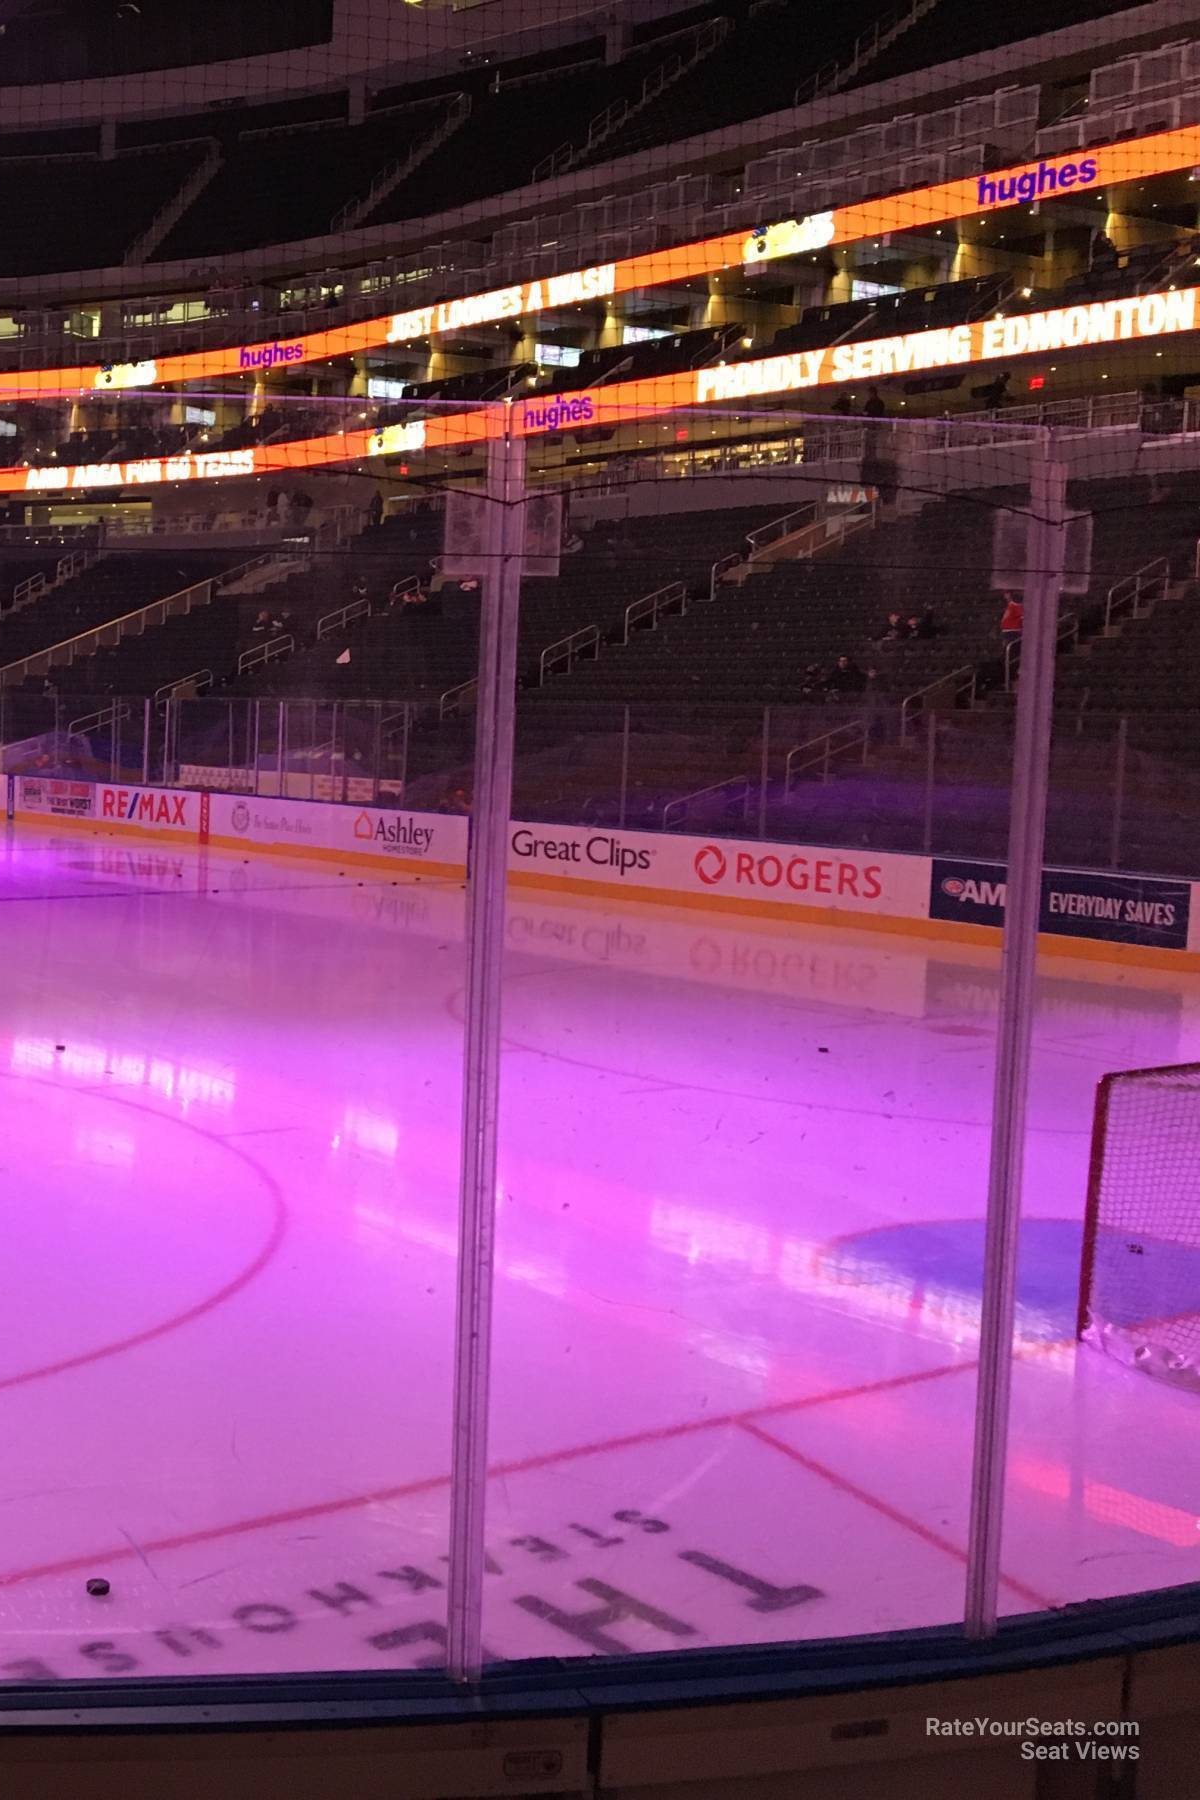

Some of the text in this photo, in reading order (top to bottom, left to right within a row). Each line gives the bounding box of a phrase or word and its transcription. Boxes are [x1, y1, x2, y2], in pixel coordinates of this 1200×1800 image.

[977, 157, 1097, 205] hughes
[387, 305, 434, 343] JUST
[527, 281, 543, 311] A
[548, 263, 616, 306] WASH
[240, 342, 303, 368] hughes
[697, 289, 1195, 402] PROUDLY SERVING EDMONTON
[522, 395, 593, 429] hughes
[103, 789, 186, 826] RE/MAX
[374, 816, 435, 853] Ashley
[511, 829, 651, 876] Great Clips
[736, 852, 882, 899] ROGERS
[1050, 892, 1122, 919] EVERYDAY
[1125, 900, 1175, 926] SAVES
